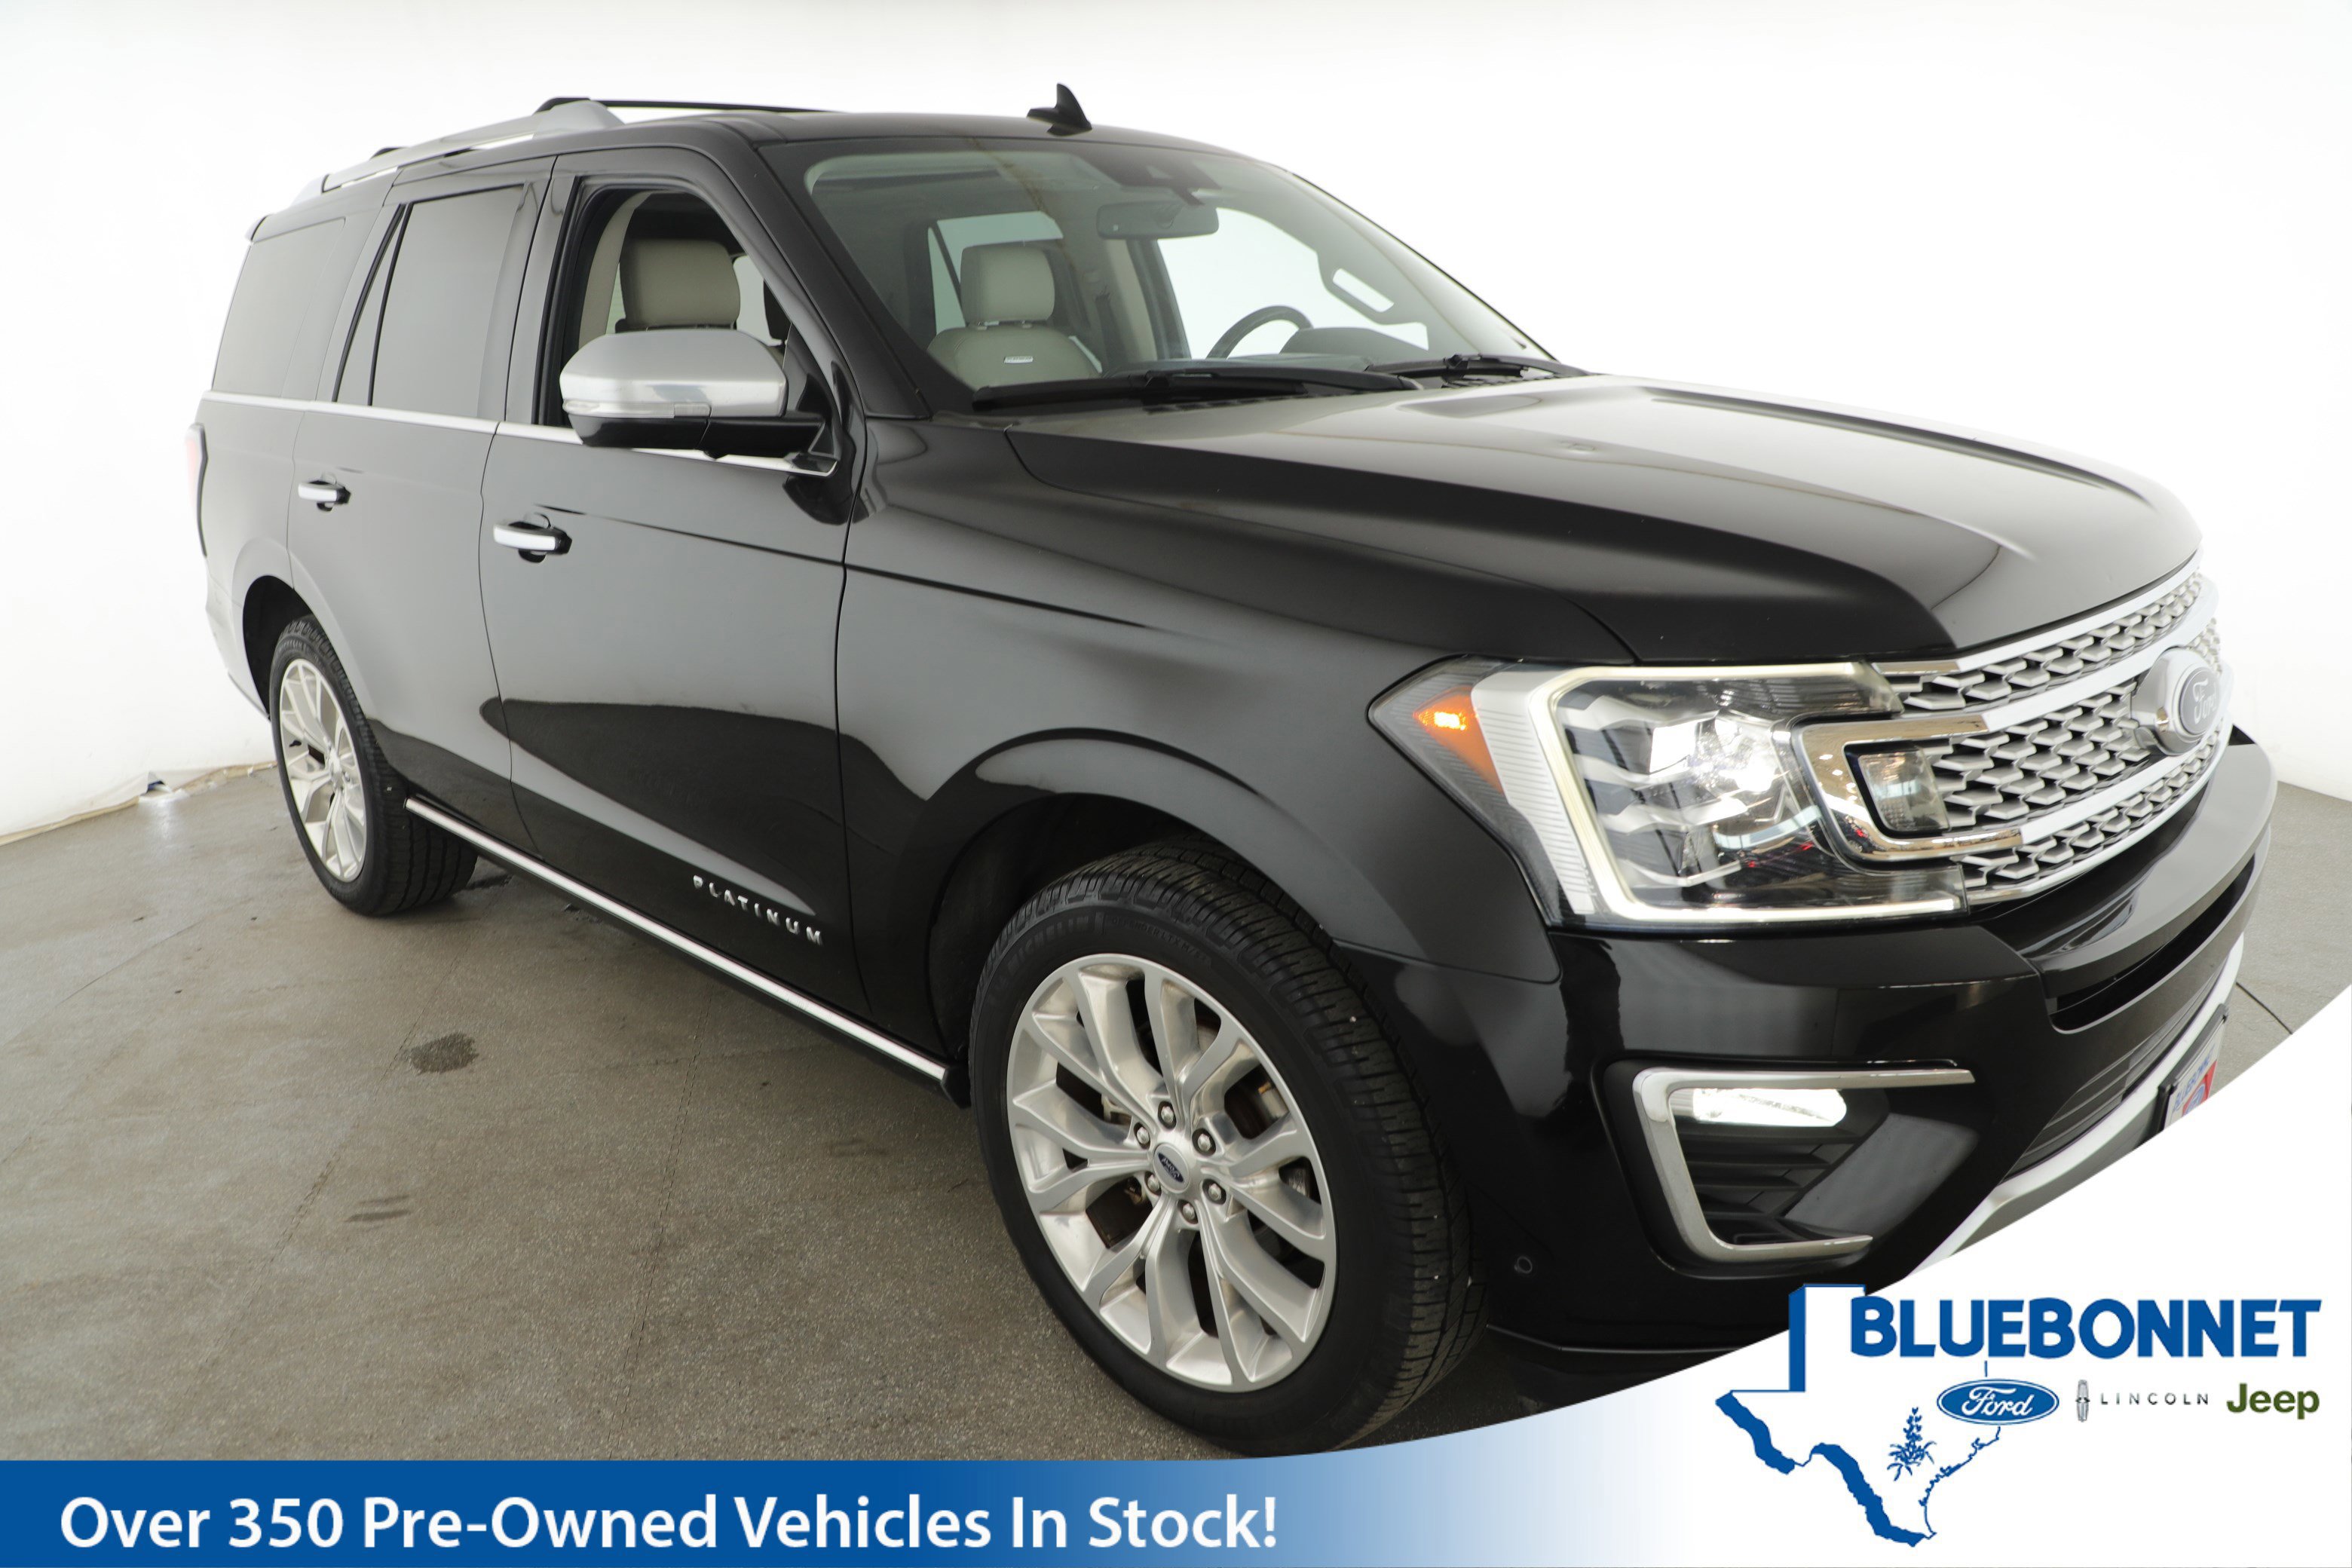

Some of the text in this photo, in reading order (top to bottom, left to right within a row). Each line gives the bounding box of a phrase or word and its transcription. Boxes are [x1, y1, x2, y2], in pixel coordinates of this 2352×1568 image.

[2193, 678, 2217, 724] Ford
[693, 874, 823, 947] PLATINUM
[1007, 915, 1090, 972] MICHELIN
